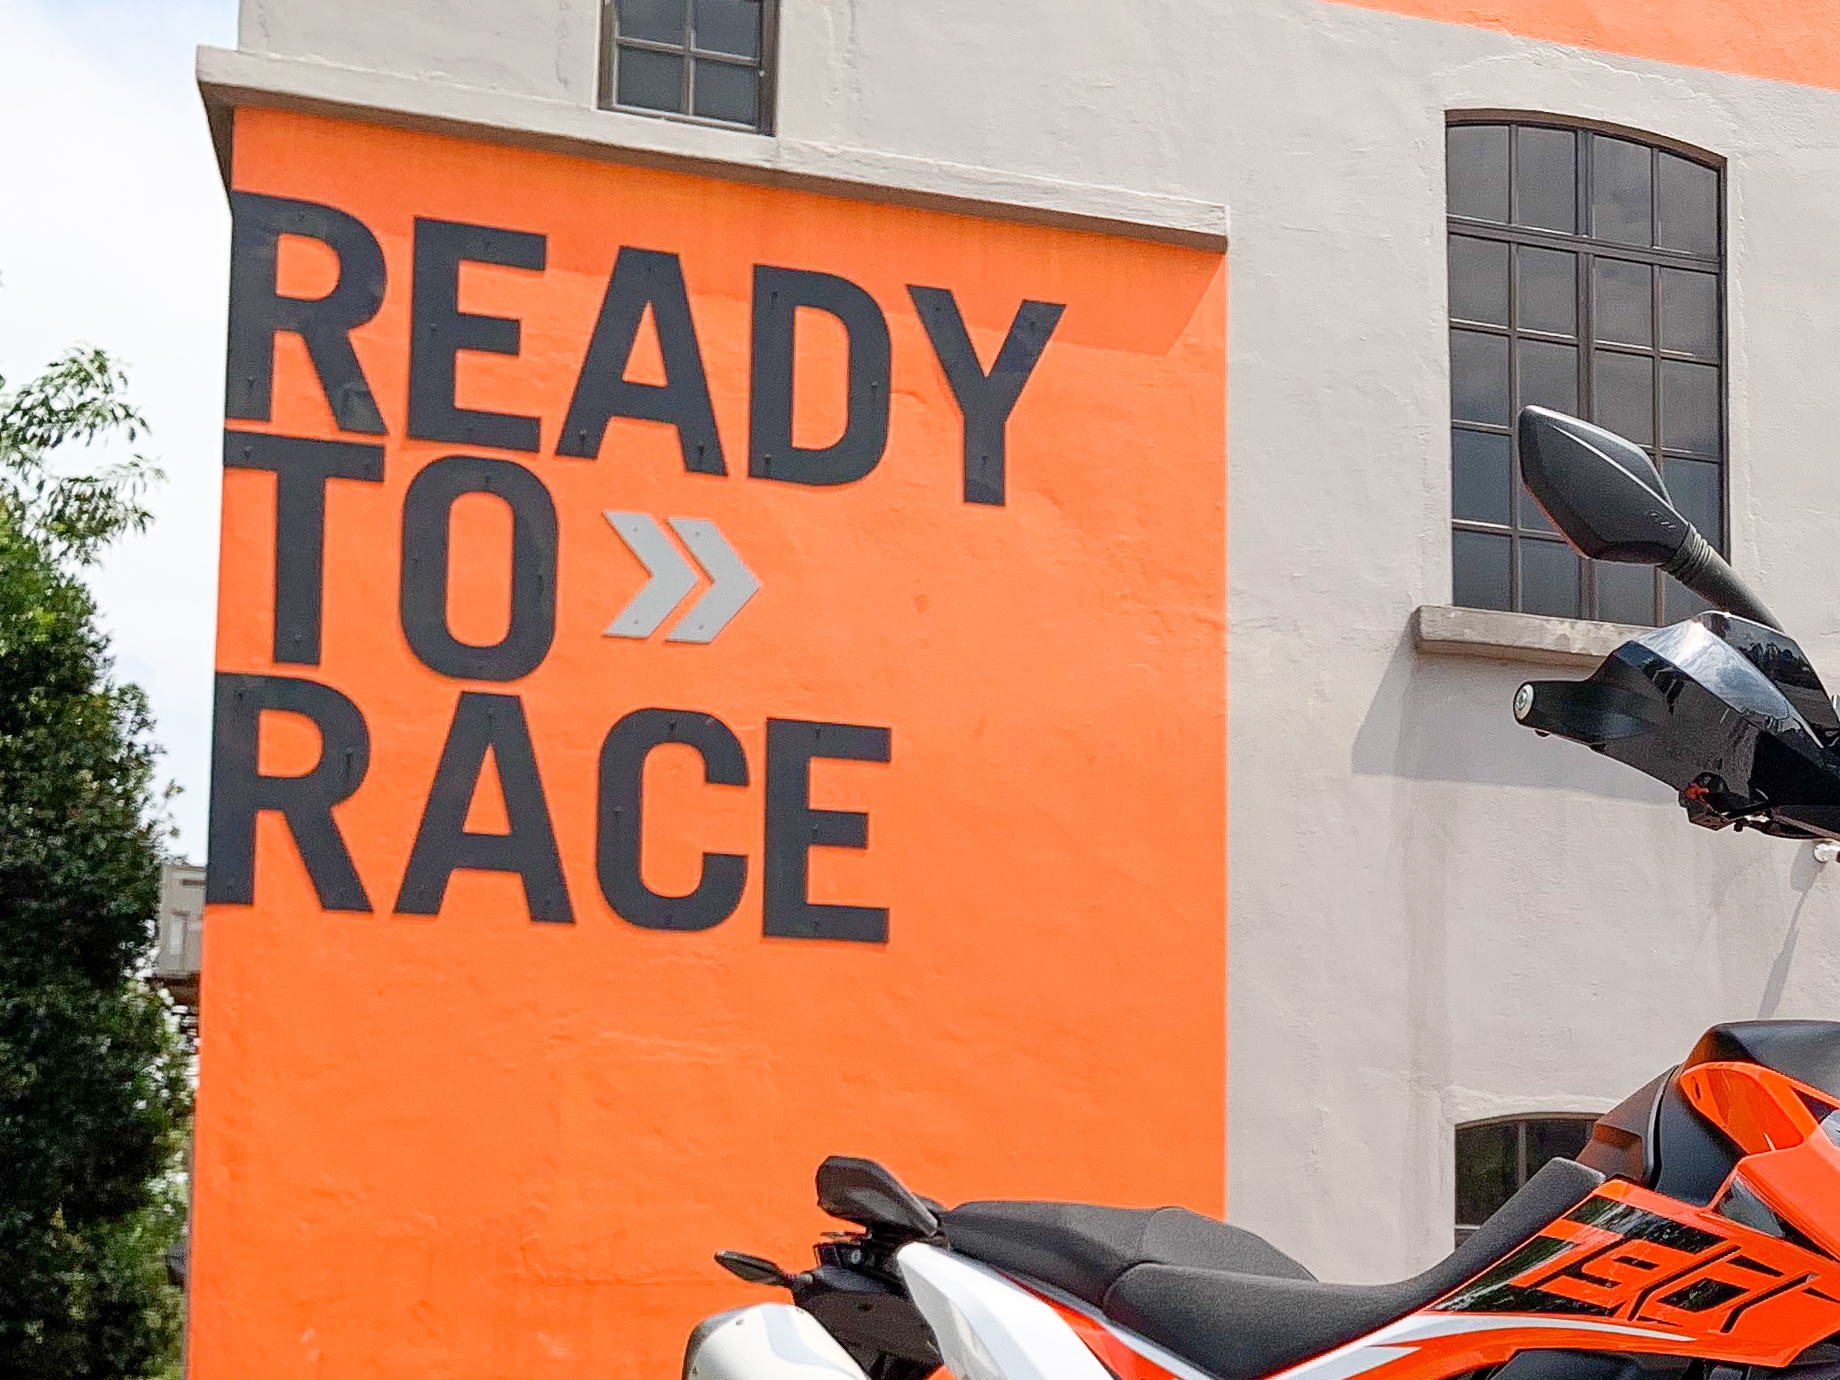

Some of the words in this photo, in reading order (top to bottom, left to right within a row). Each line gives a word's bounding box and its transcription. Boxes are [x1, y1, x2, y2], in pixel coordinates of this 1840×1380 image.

[225, 190, 1066, 507] READY
[223, 428, 559, 683] TO
[205, 671, 891, 944] RACE
